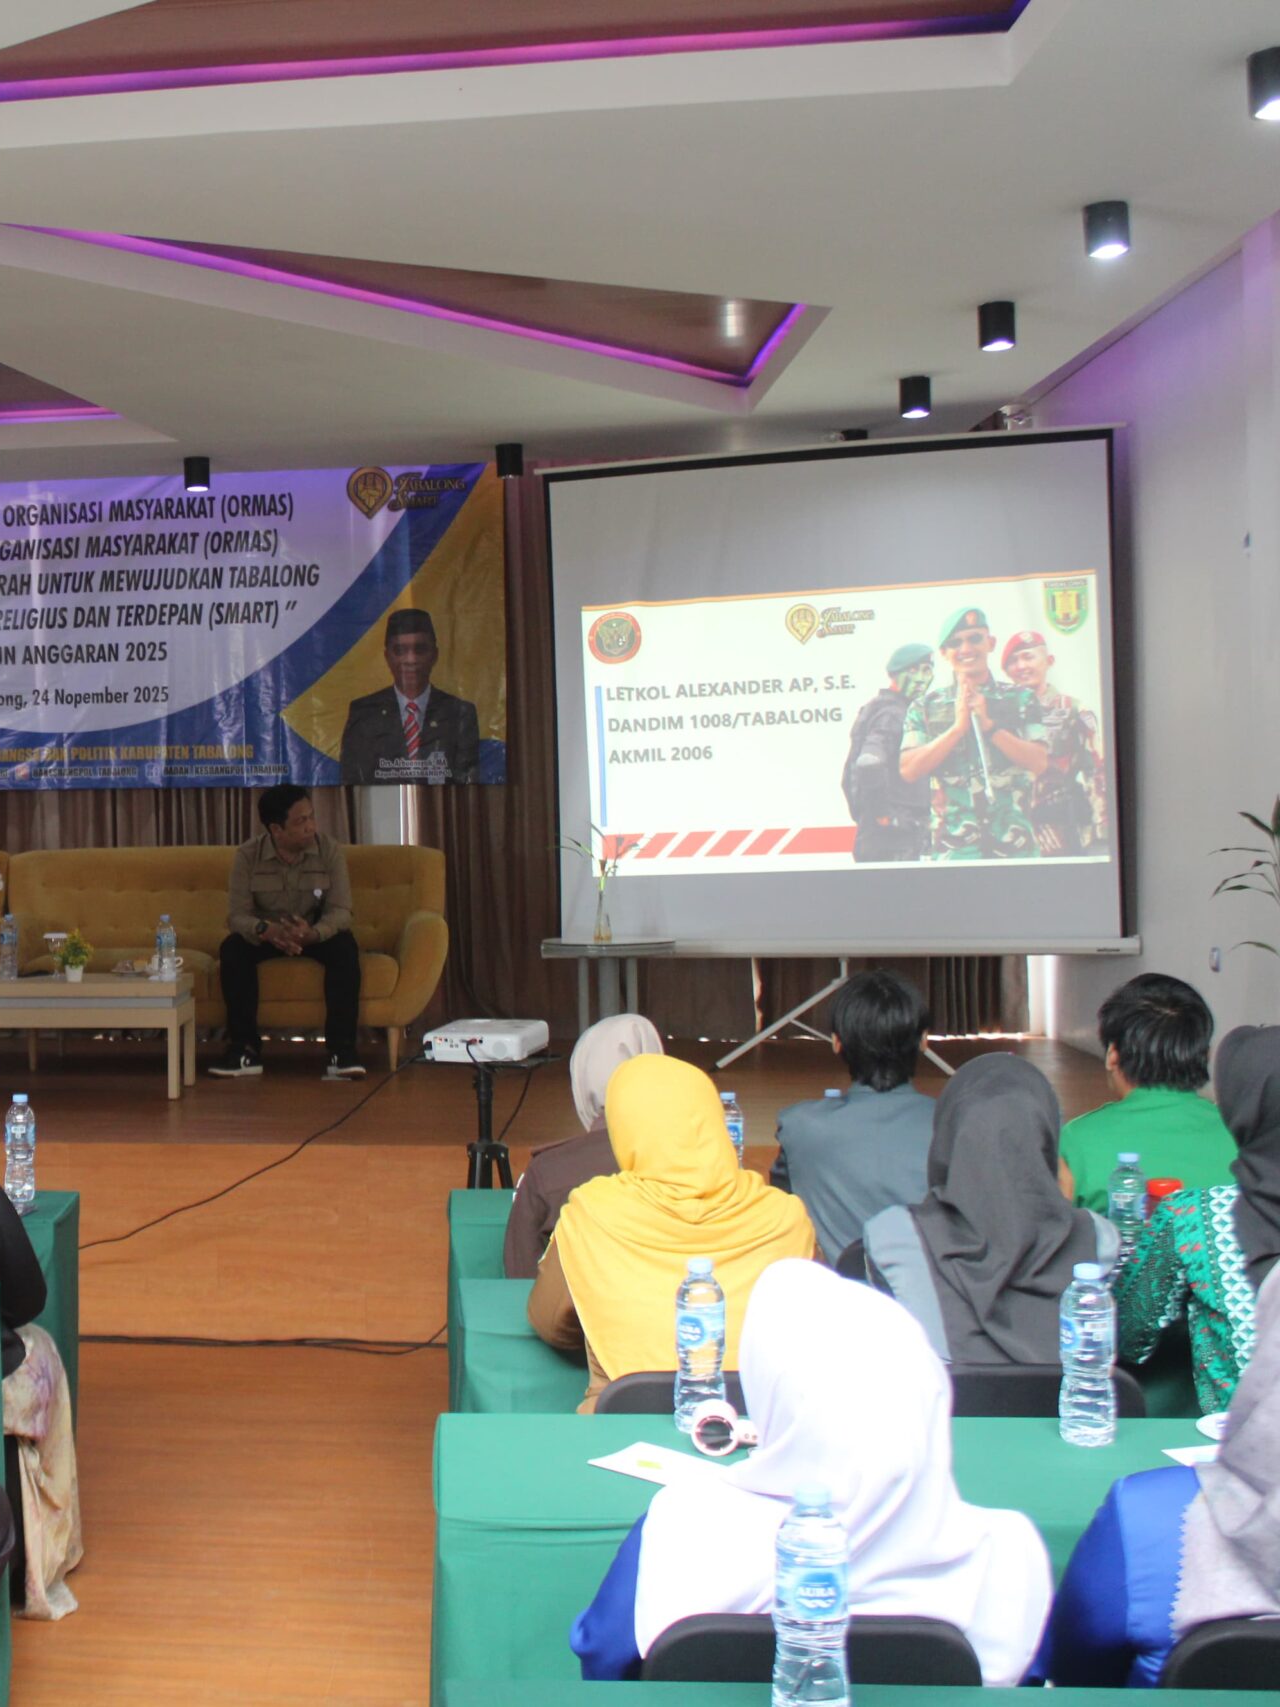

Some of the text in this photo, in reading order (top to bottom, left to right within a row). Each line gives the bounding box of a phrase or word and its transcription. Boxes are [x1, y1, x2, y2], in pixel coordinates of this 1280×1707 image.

[2, 501, 103, 527] ORGANISASI
[109, 496, 216, 522] MASYARAKAT
[221, 492, 294, 524] (ORMAS)
[84, 531, 200, 559] MASYARAKAT
[204, 528, 279, 560] (ORMAS)
[36, 570, 95, 595] UNTUK
[99, 566, 224, 593] MEWUJUDKAN
[228, 563, 320, 589] TABALONG
[72, 605, 111, 629] DAN
[115, 602, 204, 627] TERDEPAN
[208, 599, 279, 631] (SMART)
[21, 643, 120, 665] ANGGARAN
[125, 641, 168, 662] 2025
[32, 689, 50, 706] 24
[54, 686, 129, 709] Nopember
[133, 686, 170, 704] 2025
[606, 675, 856, 702] LETKOL ALEXANDER AP, S.E.
[607, 707, 843, 733] DANDIM 1008/TABALONG
[71, 745, 117, 761] POLITIK
[119, 744, 190, 760] KABUPATEN
[192, 743, 254, 759] TABALONG
[608, 745, 713, 765] AKMIL 2006
